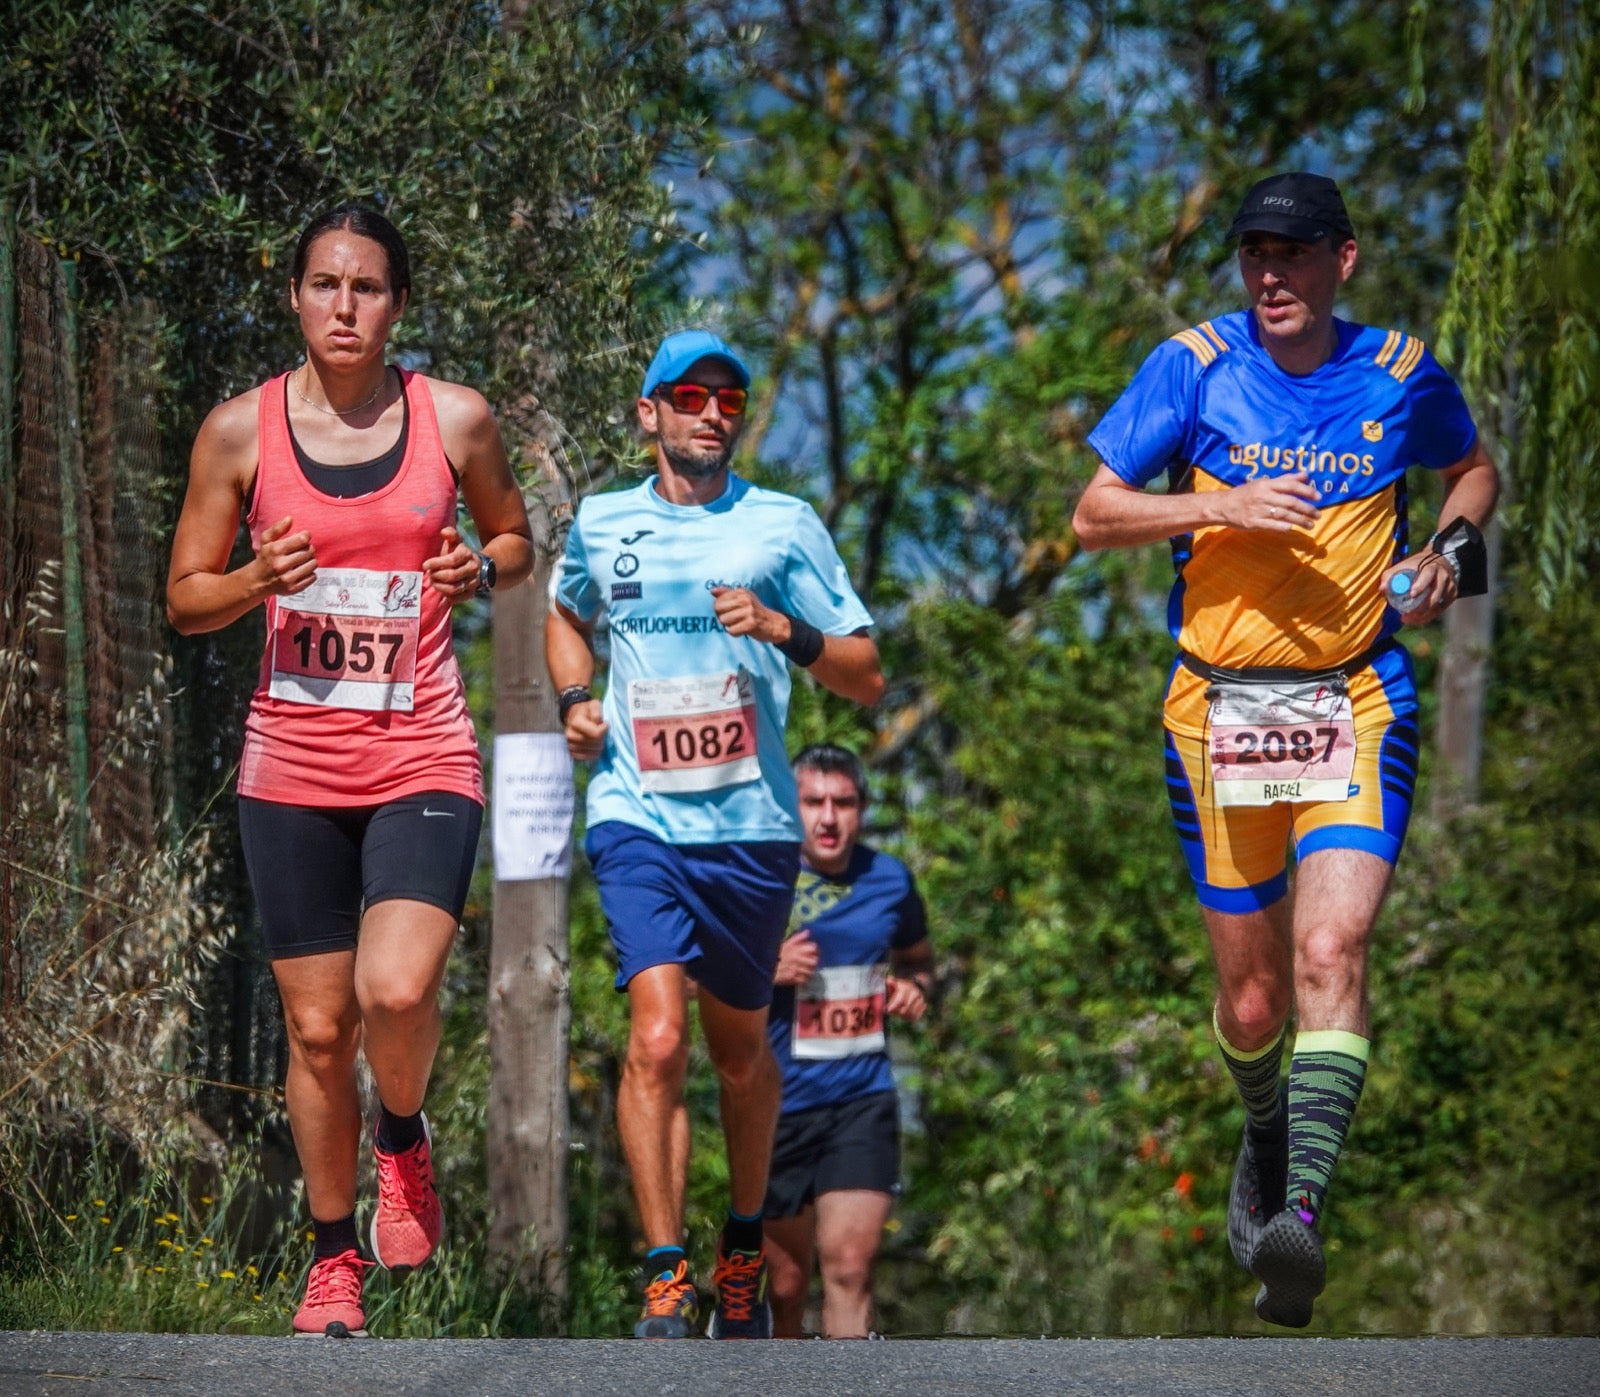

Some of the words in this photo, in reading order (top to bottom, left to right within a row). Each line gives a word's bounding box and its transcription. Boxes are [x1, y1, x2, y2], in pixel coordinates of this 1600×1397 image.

[293, 626, 404, 674] 1057
[652, 721, 746, 763] 1082
[1234, 728, 1339, 763] 2087
